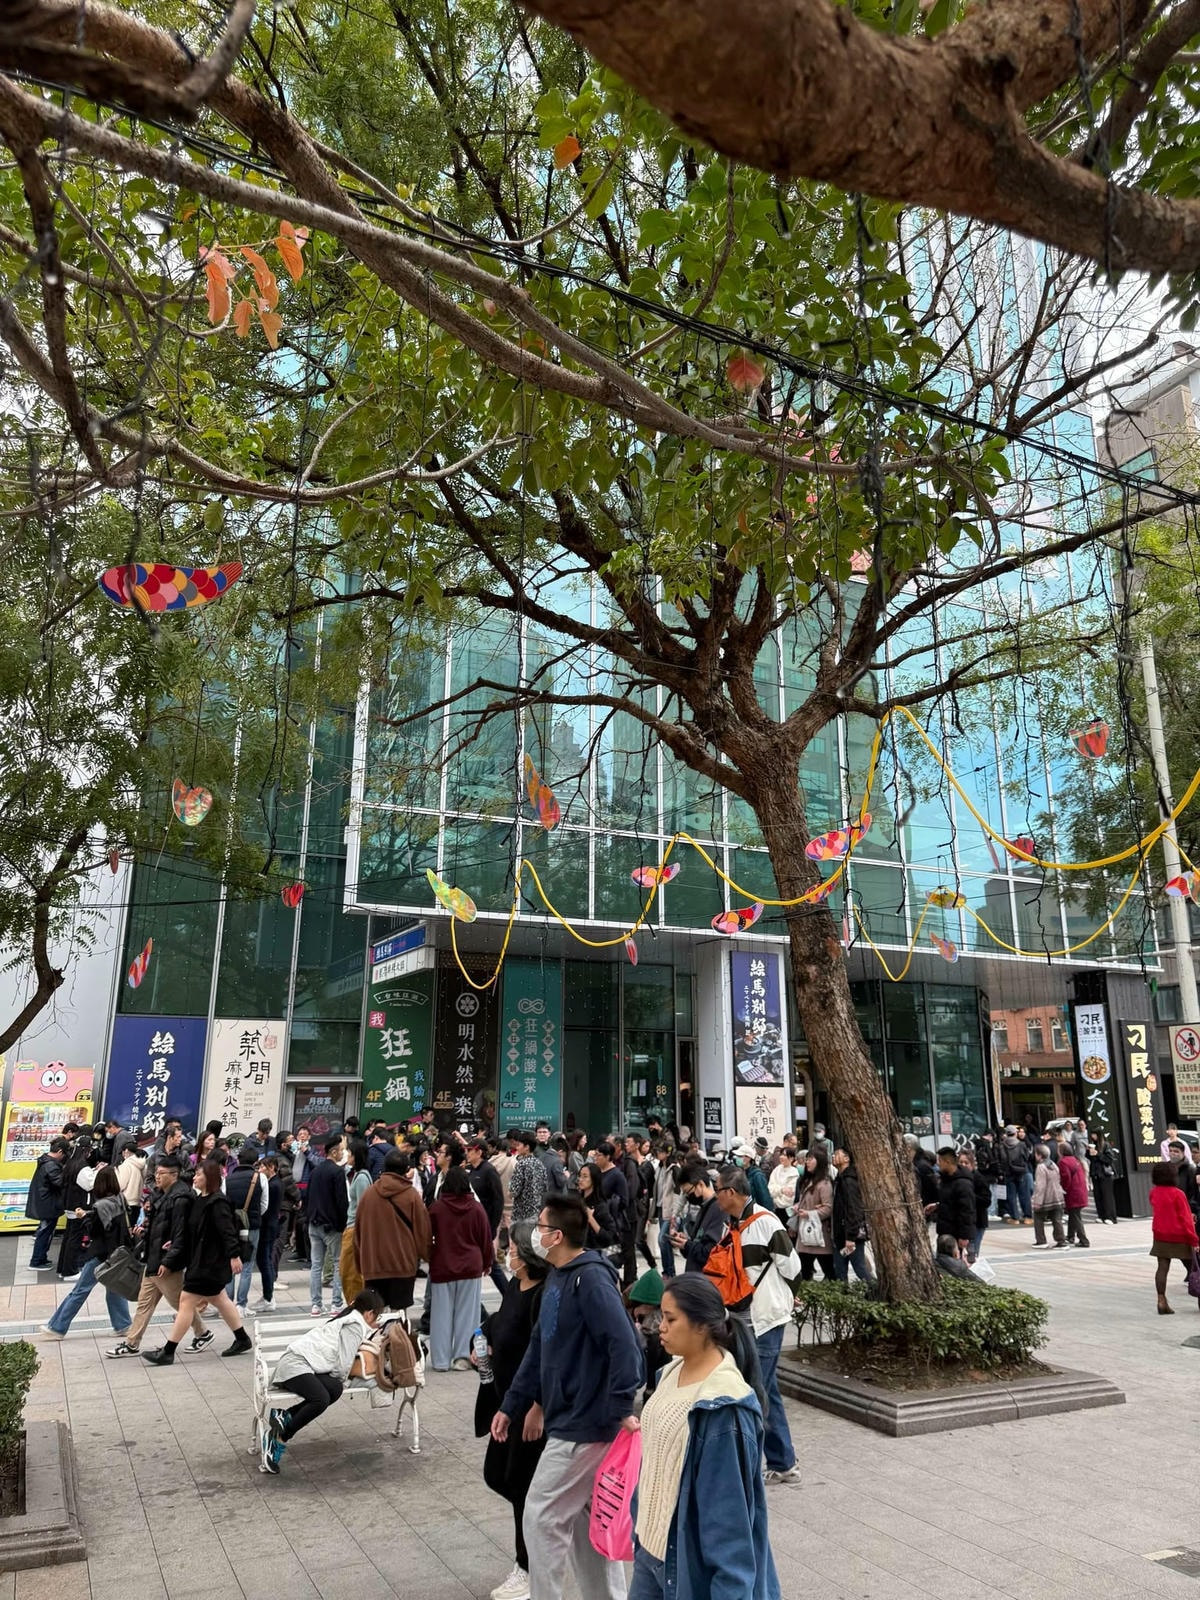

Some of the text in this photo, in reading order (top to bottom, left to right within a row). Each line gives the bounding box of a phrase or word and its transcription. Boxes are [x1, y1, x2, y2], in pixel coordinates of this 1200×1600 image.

[371, 1012, 383, 1026] 我
[1080, 1013, 1100, 1025] 刁民
[239, 1029, 271, 1085] 築間
[379, 1028, 413, 1102] 狂一鍋
[222, 1060, 242, 1128] 麻辣火鍋
[366, 1090, 382, 1101] 4F
[436, 1091, 451, 1101] 4F
[504, 1091, 517, 1101] 4F
[656, 1085, 667, 1095] 88
[755, 1095, 776, 1133] 築間
[128, 1125, 138, 1134] 3F
